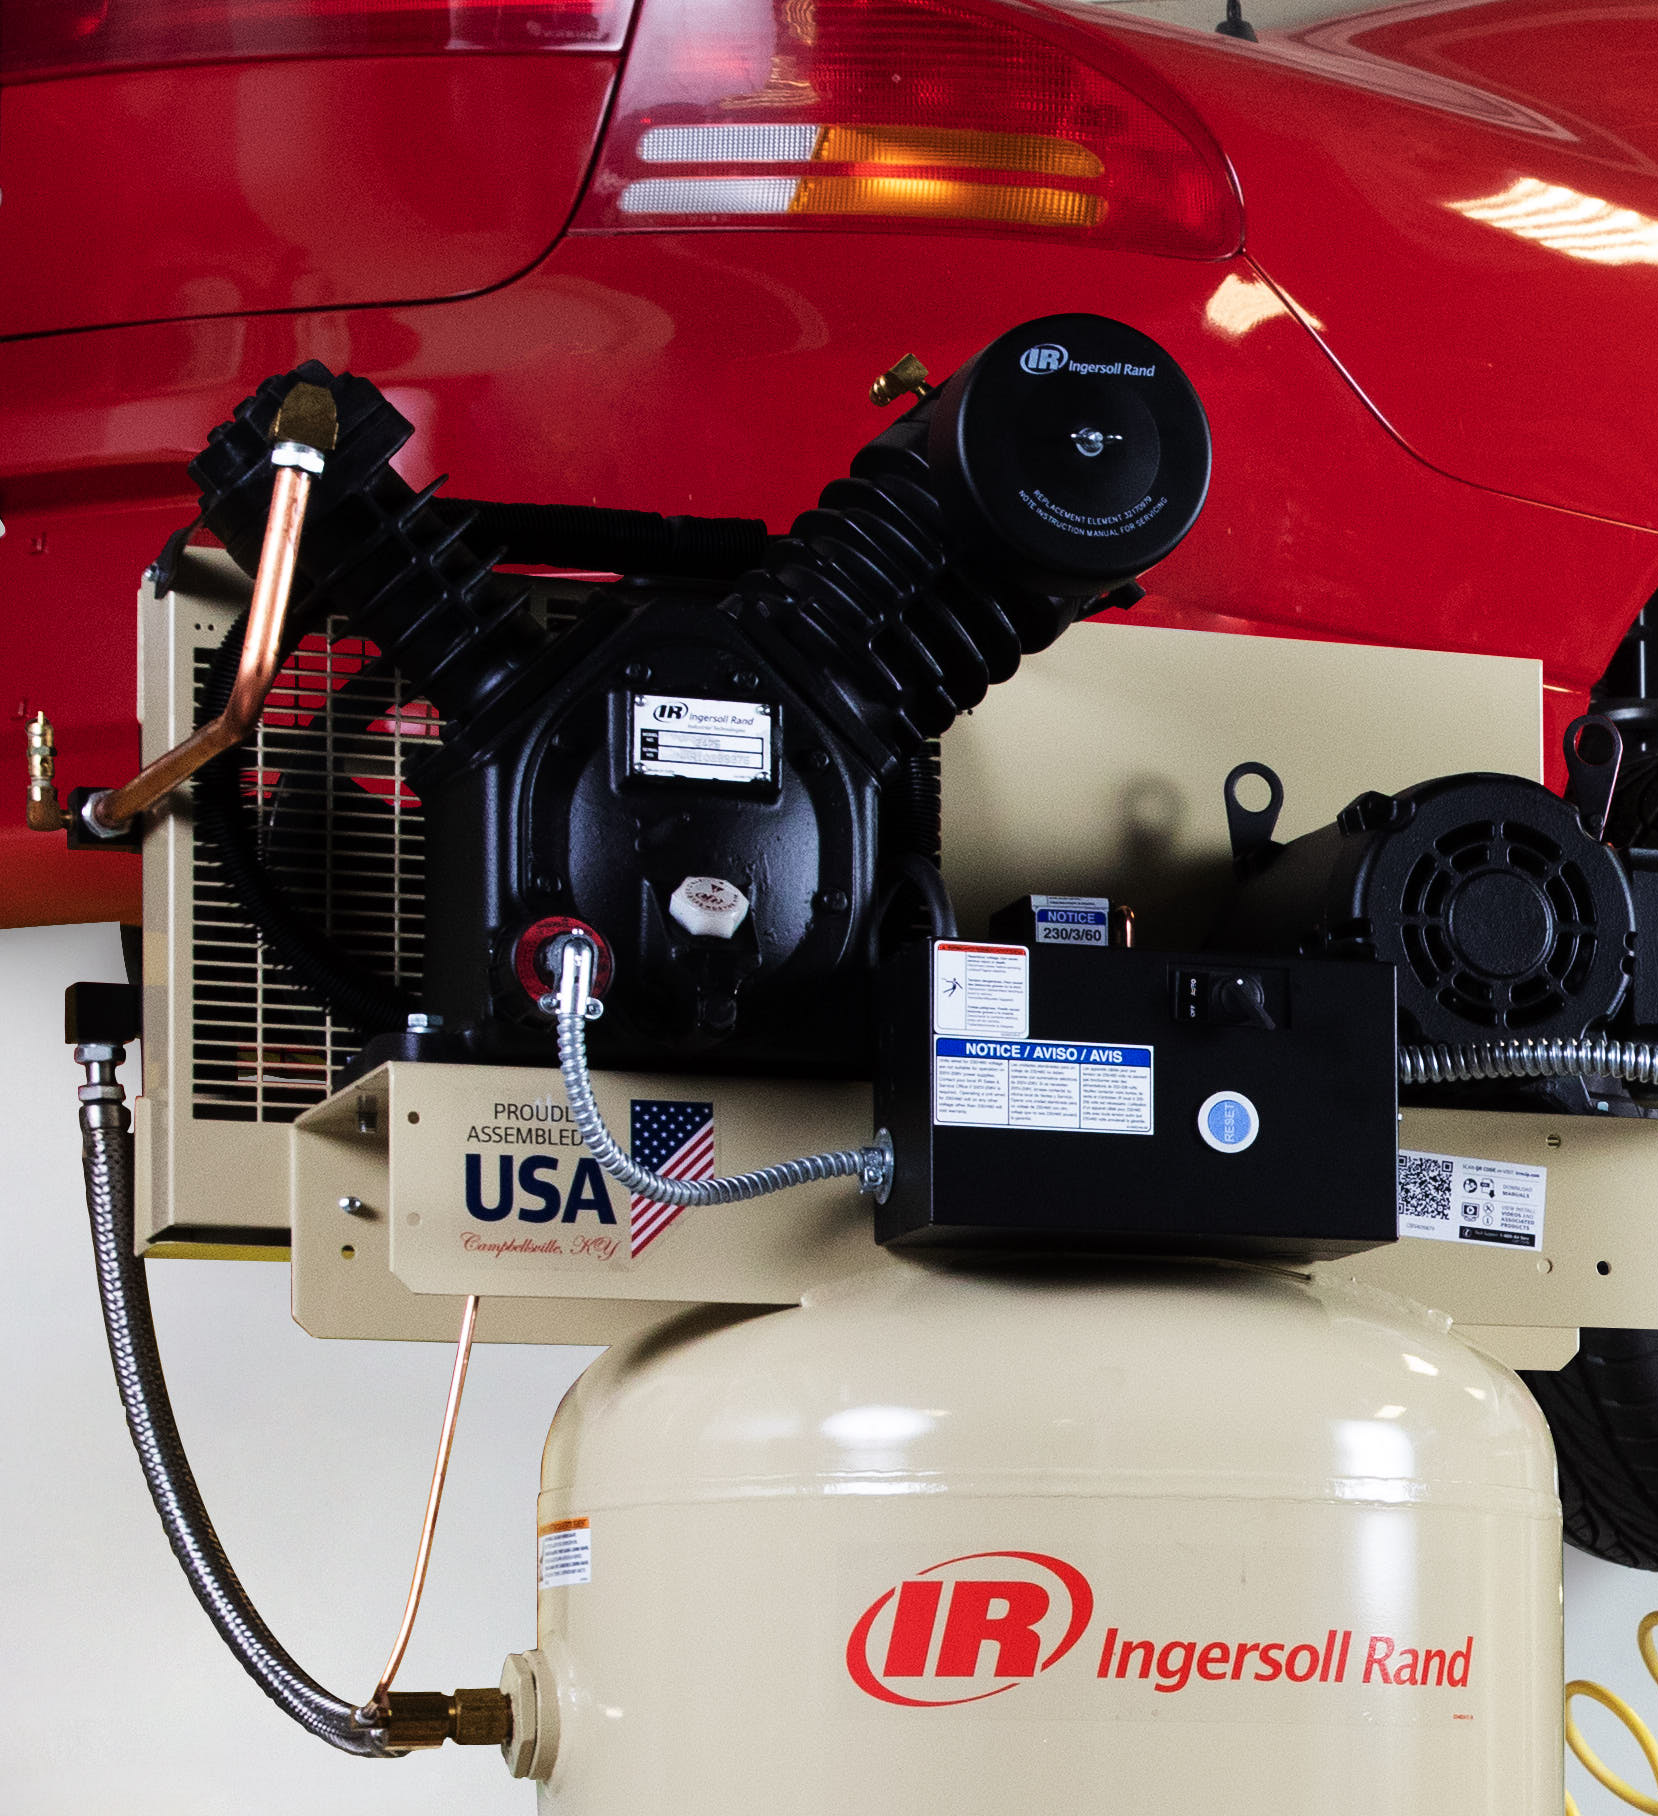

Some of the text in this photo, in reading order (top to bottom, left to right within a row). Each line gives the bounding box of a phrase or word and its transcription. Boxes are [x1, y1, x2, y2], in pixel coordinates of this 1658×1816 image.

[1069, 360, 1122, 374] Ingersoll
[1123, 364, 1155, 377] Rand
[1018, 489, 1168, 537] NOTE INSTRUCTION MANUAL FOR SERVICING
[1033, 489, 1086, 525] REPLACEMENT
[1087, 514, 1122, 526] ELEMENT
[689, 713, 729, 725] Ingersoll
[730, 716, 754, 726] Rand
[1048, 911, 1096, 923] NOTICE
[1043, 927, 1102, 942] 230/3/60
[965, 1042, 1021, 1058] NOTICE
[1033, 1046, 1078, 1061] AVISO
[1090, 1049, 1123, 1063] AVIS
[494, 1102, 574, 1123] PROUDL
[1224, 1102, 1236, 1143] RESET
[467, 1125, 585, 1147] ASSEMBLED
[465, 1153, 617, 1225] USA
[1097, 1627, 1353, 1693] Ingersoll
[1361, 1635, 1474, 1687] Rand
